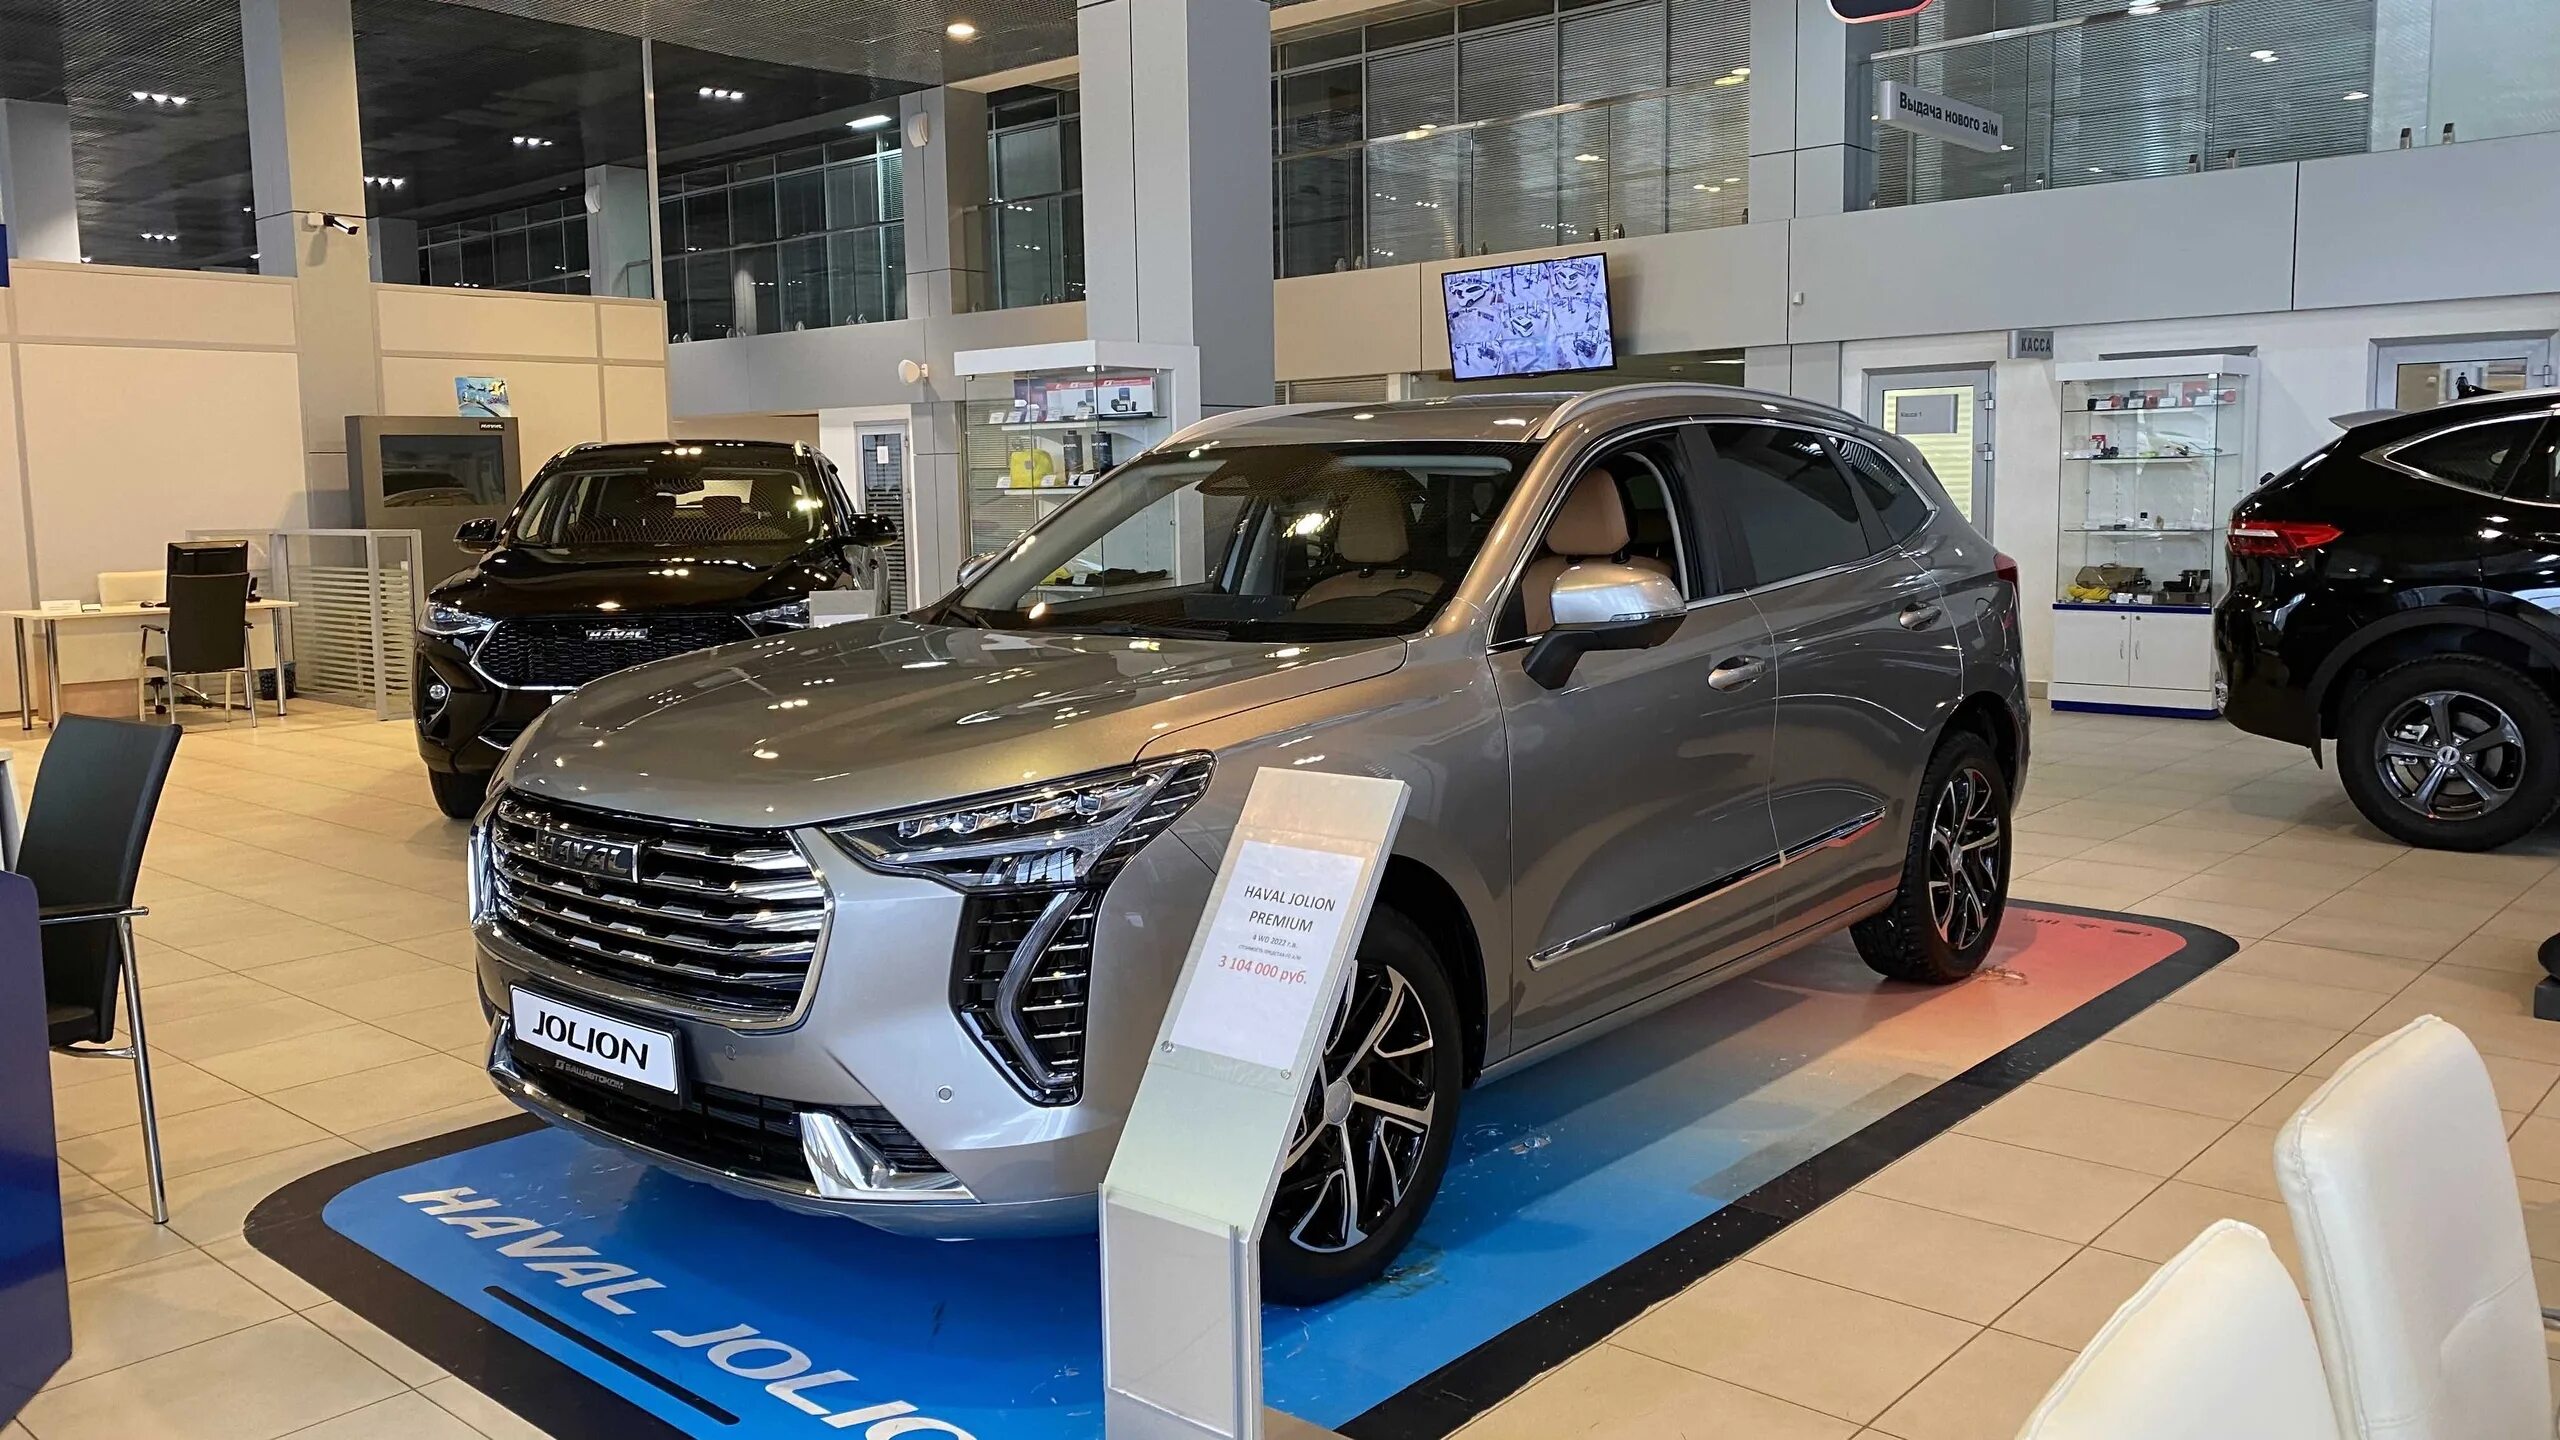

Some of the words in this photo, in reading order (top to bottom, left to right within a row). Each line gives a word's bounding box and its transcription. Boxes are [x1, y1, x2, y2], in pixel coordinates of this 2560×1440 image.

[1899, 91, 1942, 119] Выдача
[1944, 109, 1980, 131] нового
[1982, 119, 1998, 136] а/м
[2021, 337, 2051, 352] КАССА
[588, 629, 648, 640] HAVAL
[541, 834, 629, 875] HAVAL
[1244, 885, 1285, 904] HAVAL
[1288, 893, 1336, 912] JOLION
[1249, 910, 1313, 933] PREMIUM
[1270, 937, 1287, 946] 2022
[1218, 955, 1227, 968] 3
[1229, 957, 1253, 973] 104
[1254, 962, 1279, 978] 000
[1279, 970, 1307, 985] руб.
[532, 1010, 649, 1070] JOLION
[398, 1186, 667, 1315] HAVAL
